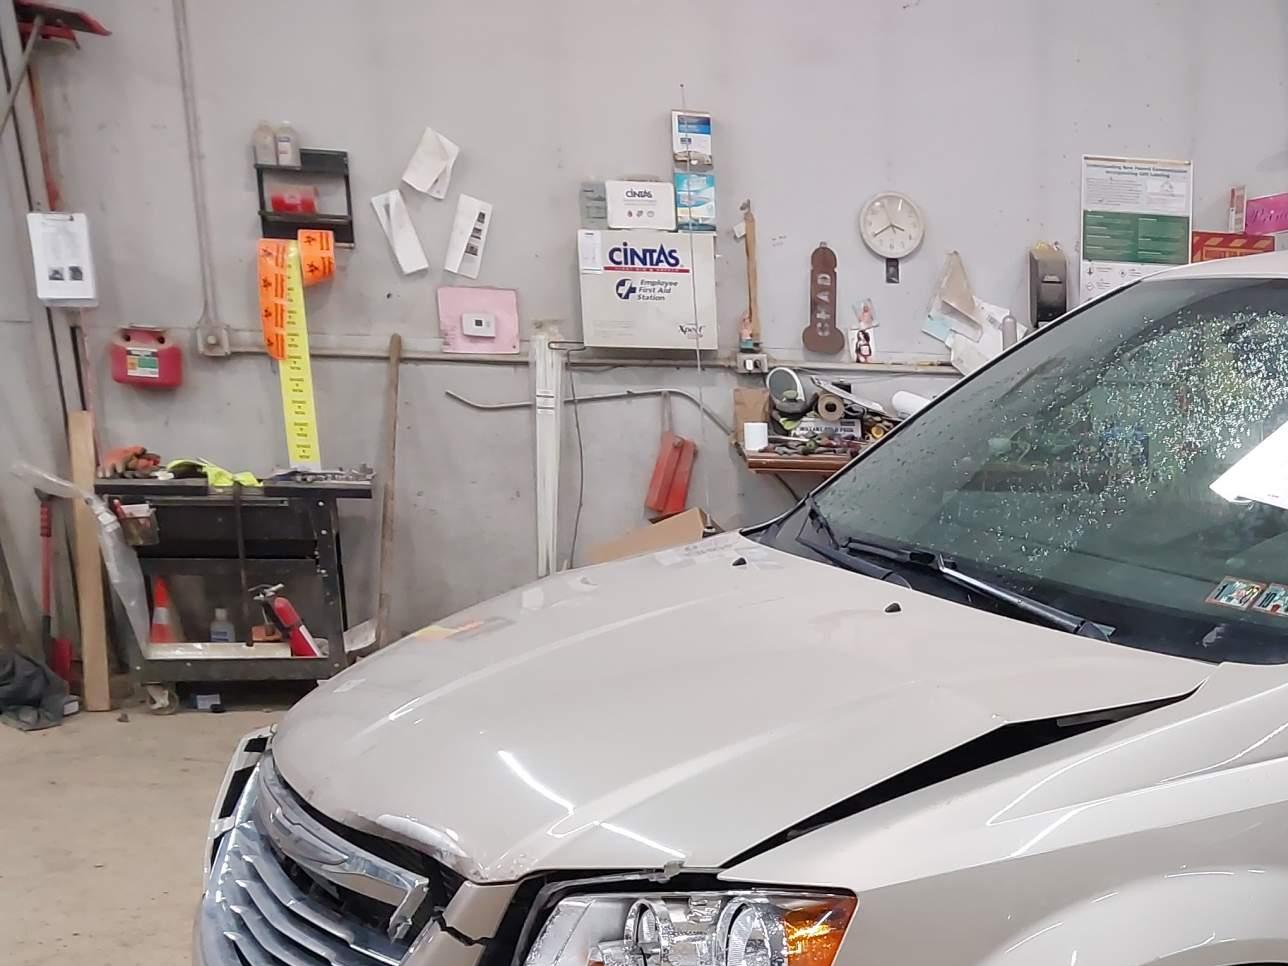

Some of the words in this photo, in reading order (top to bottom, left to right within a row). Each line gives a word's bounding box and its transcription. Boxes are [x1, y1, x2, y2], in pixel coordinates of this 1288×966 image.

[640, 279, 679, 288] Employee
[638, 287, 657, 295] First
[657, 286, 672, 295] Aid
[637, 294, 666, 302] Station
